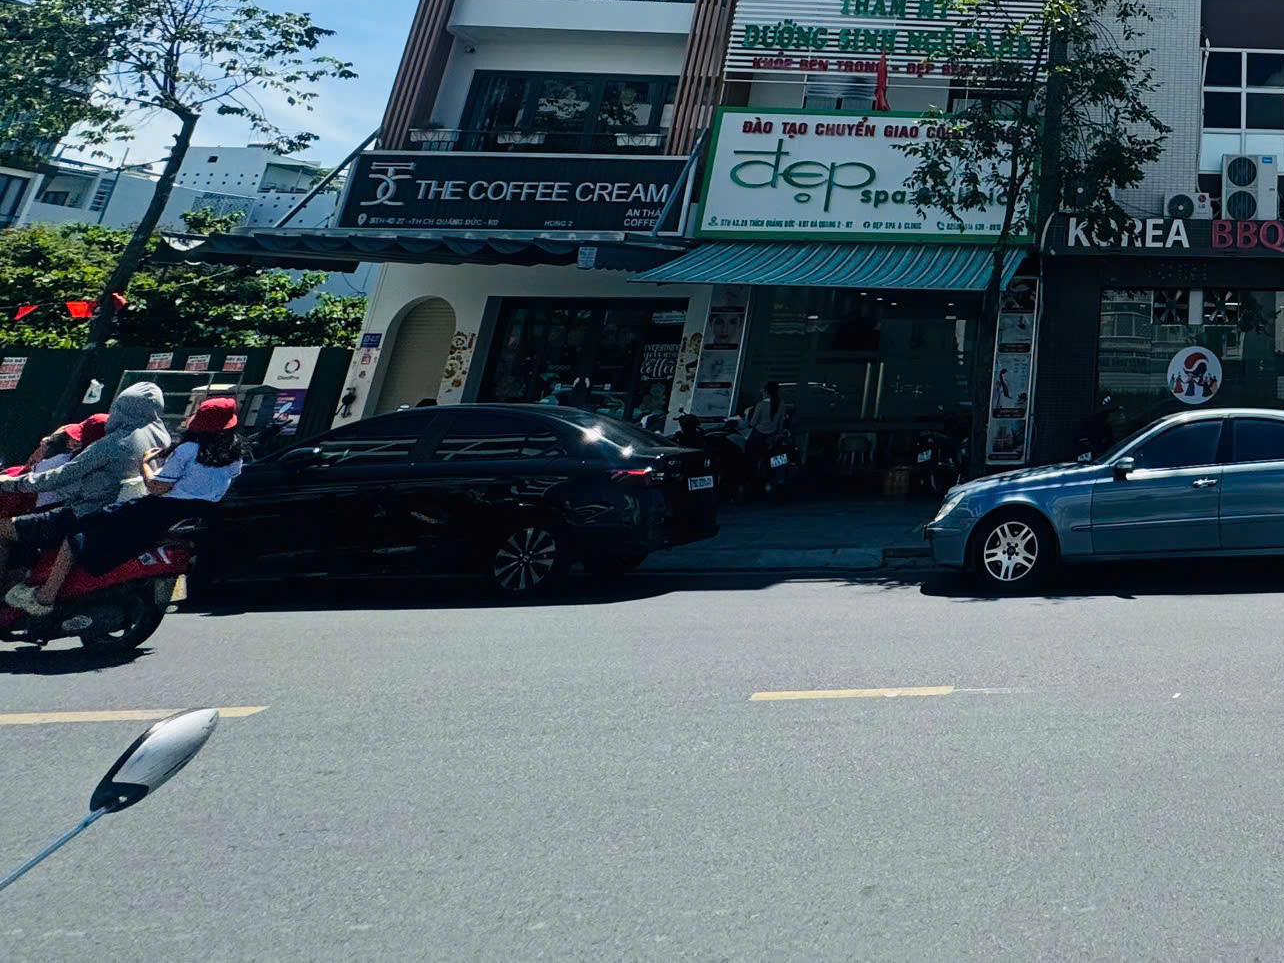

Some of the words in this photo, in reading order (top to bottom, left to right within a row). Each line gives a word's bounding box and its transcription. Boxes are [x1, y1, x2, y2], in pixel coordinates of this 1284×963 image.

[839, 28, 897, 53] SINH
[742, 117, 773, 135] ĐÀO
[781, 121, 808, 139] TẠO
[815, 117, 876, 137] CHUYỂN
[884, 124, 919, 138] GIAO
[729, 139, 877, 212] đẹp
[415, 180, 465, 201] THE
[468, 180, 572, 202] COFFEE
[575, 182, 671, 203] CREAM
[859, 189, 907, 208] spa
[625, 209, 641, 217] AN
